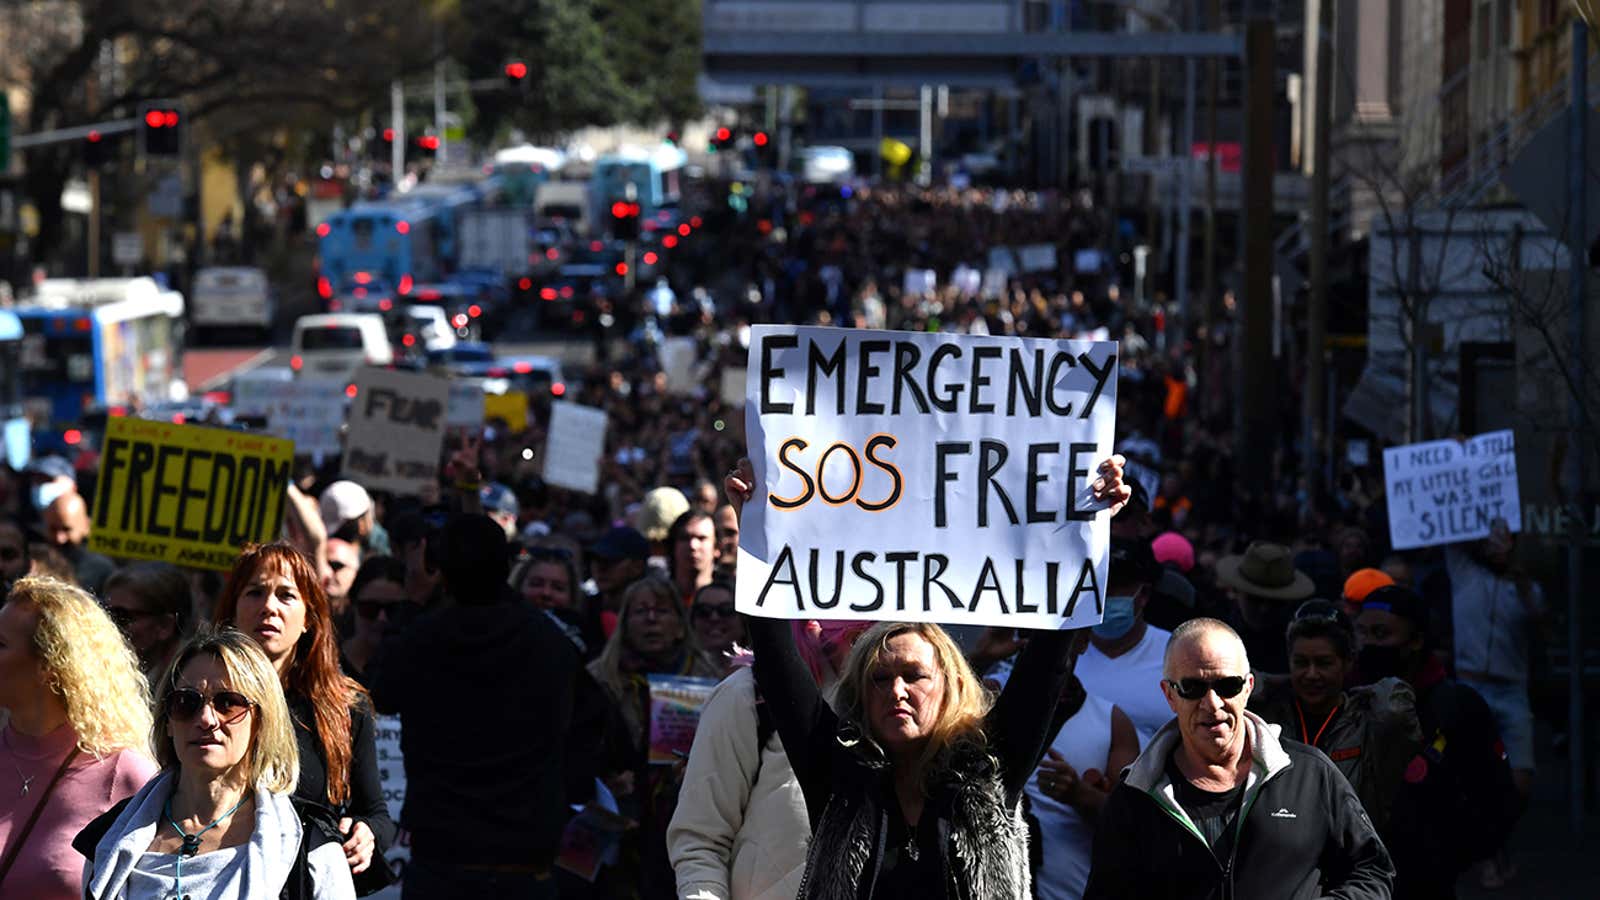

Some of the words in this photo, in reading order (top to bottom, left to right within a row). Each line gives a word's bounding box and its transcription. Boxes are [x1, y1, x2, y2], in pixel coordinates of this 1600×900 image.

[760, 334, 1117, 418] EMERGENCY
[1394, 453, 1399, 472] I
[1410, 446, 1453, 466] NEED
[1483, 434, 1514, 455] TELL
[96, 438, 290, 546] FREEDOM
[768, 432, 905, 512] SOS
[934, 438, 1098, 527] FREE
[1422, 466, 1470, 492] LITTLE
[1432, 488, 1473, 506] WAS
[1419, 499, 1504, 540] SILENT
[95, 535, 121, 549] THE
[756, 543, 1103, 617] AUSTRALIA
